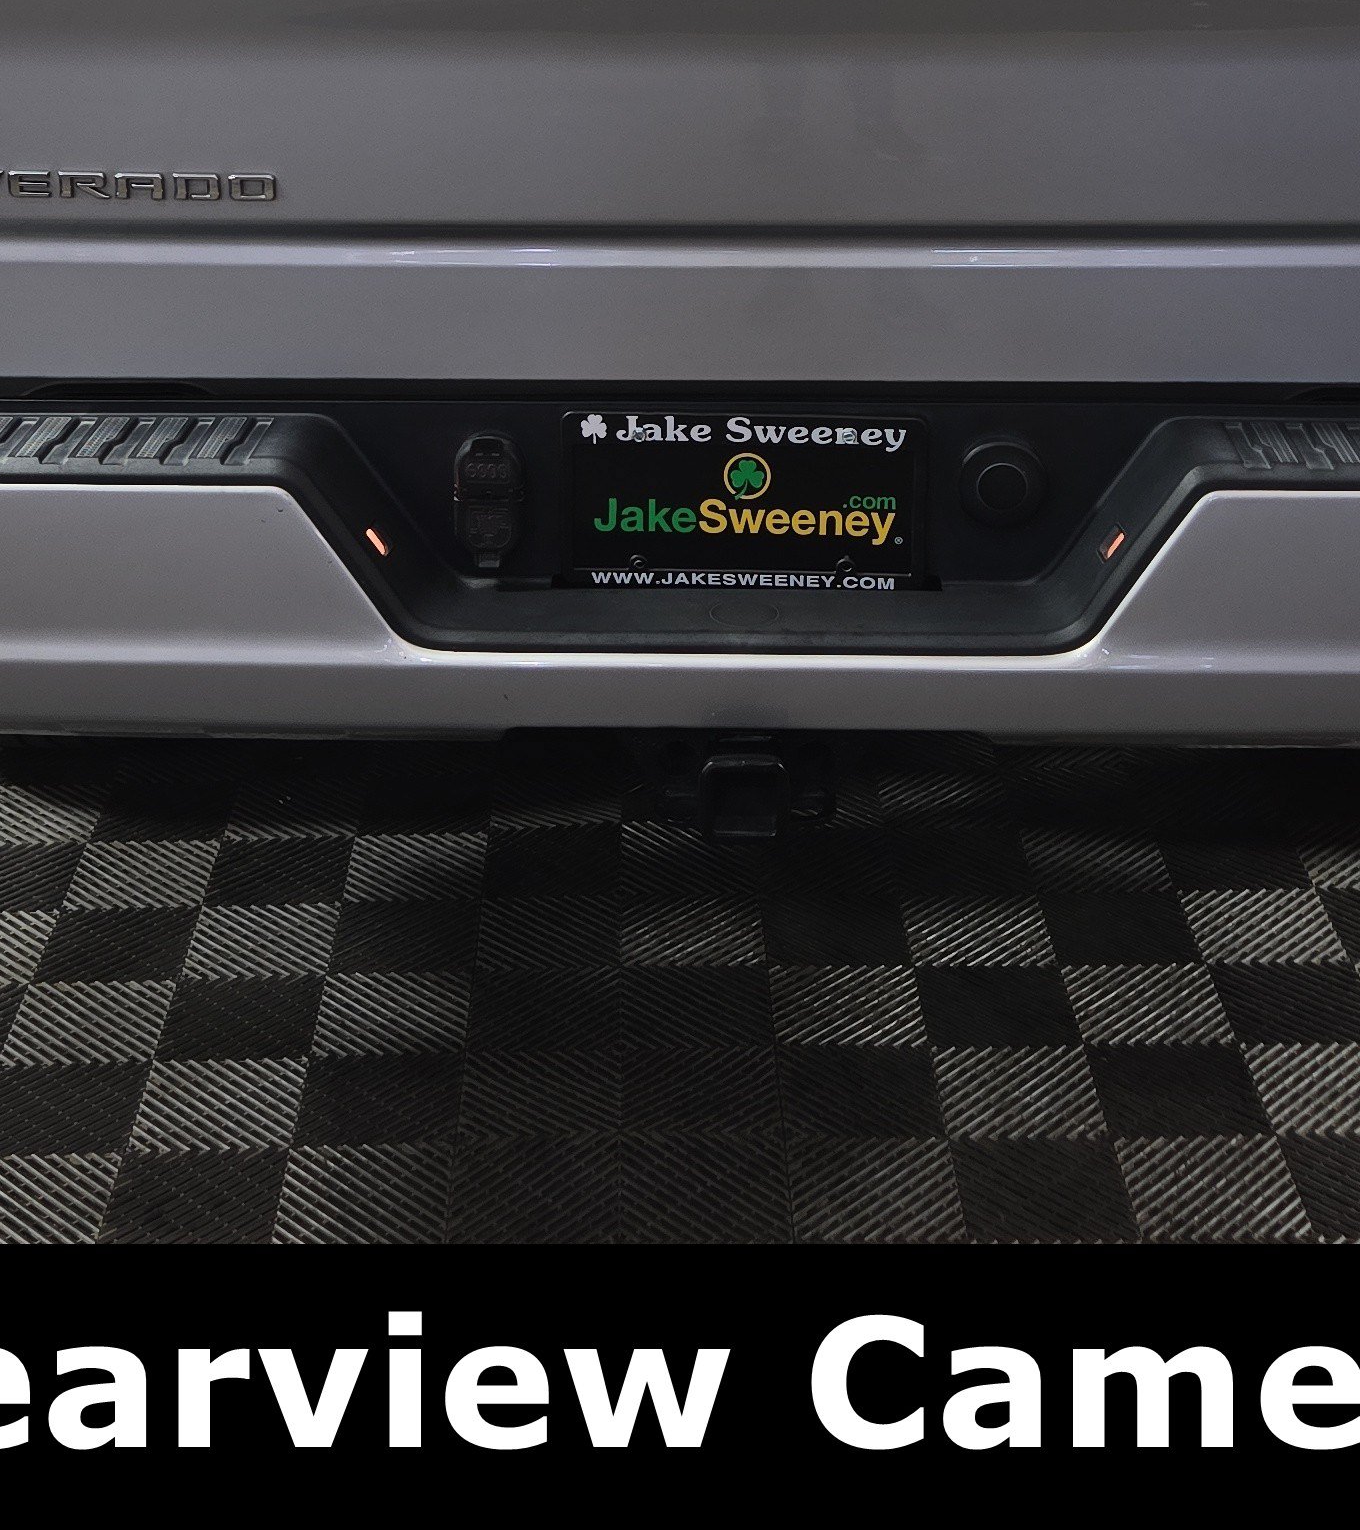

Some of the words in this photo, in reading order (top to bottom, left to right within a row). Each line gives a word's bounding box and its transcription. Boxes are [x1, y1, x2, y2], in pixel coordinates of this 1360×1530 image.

[616, 415, 712, 443] Jake
[725, 416, 907, 452] Sweeney
[591, 571, 895, 591] WWW.JAKESWEENEY.COM
